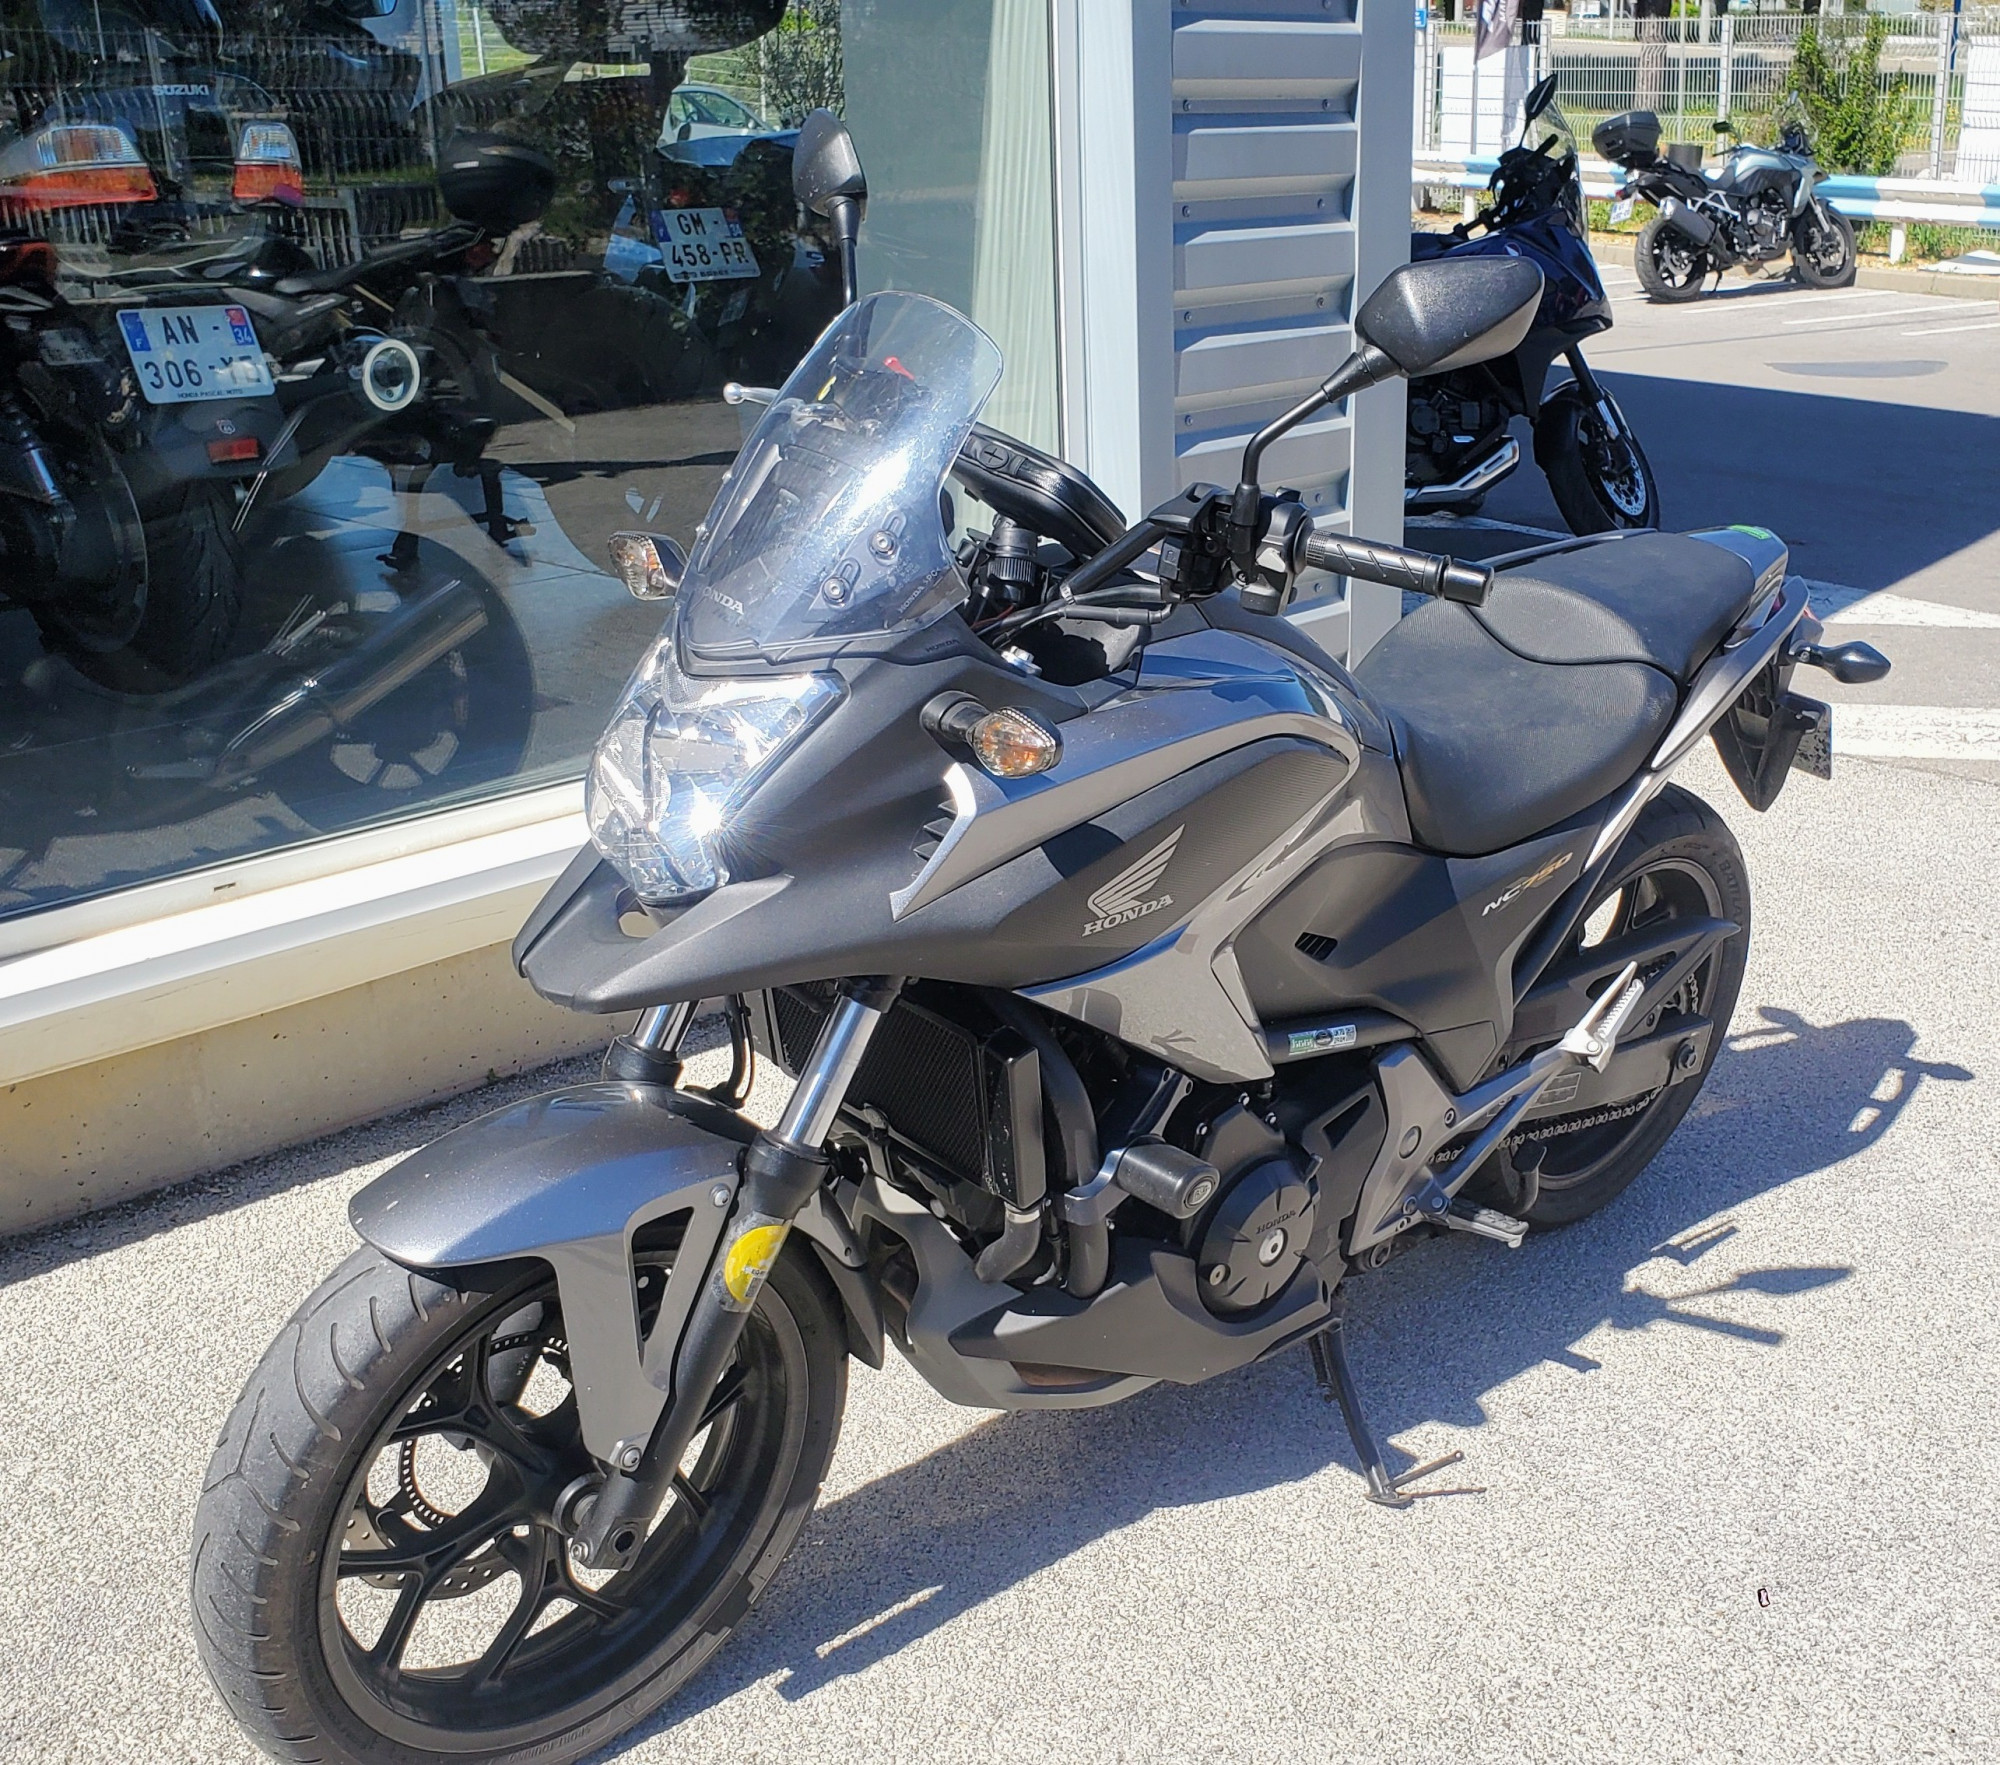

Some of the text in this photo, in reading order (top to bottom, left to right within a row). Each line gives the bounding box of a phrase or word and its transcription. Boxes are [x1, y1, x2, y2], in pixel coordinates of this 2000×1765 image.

[152, 84, 210, 96] SUZUKI
[676, 213, 707, 236] GM
[136, 338, 143, 348] F
[161, 315, 200, 345] AN
[233, 327, 253, 345] 34
[144, 354, 262, 390] 306-
[701, 585, 745, 616] ONDA
[1719, 859, 1743, 923] BATTLA
[1081, 894, 1175, 937] HONDA
[1255, 1209, 1297, 1234] HONDA
